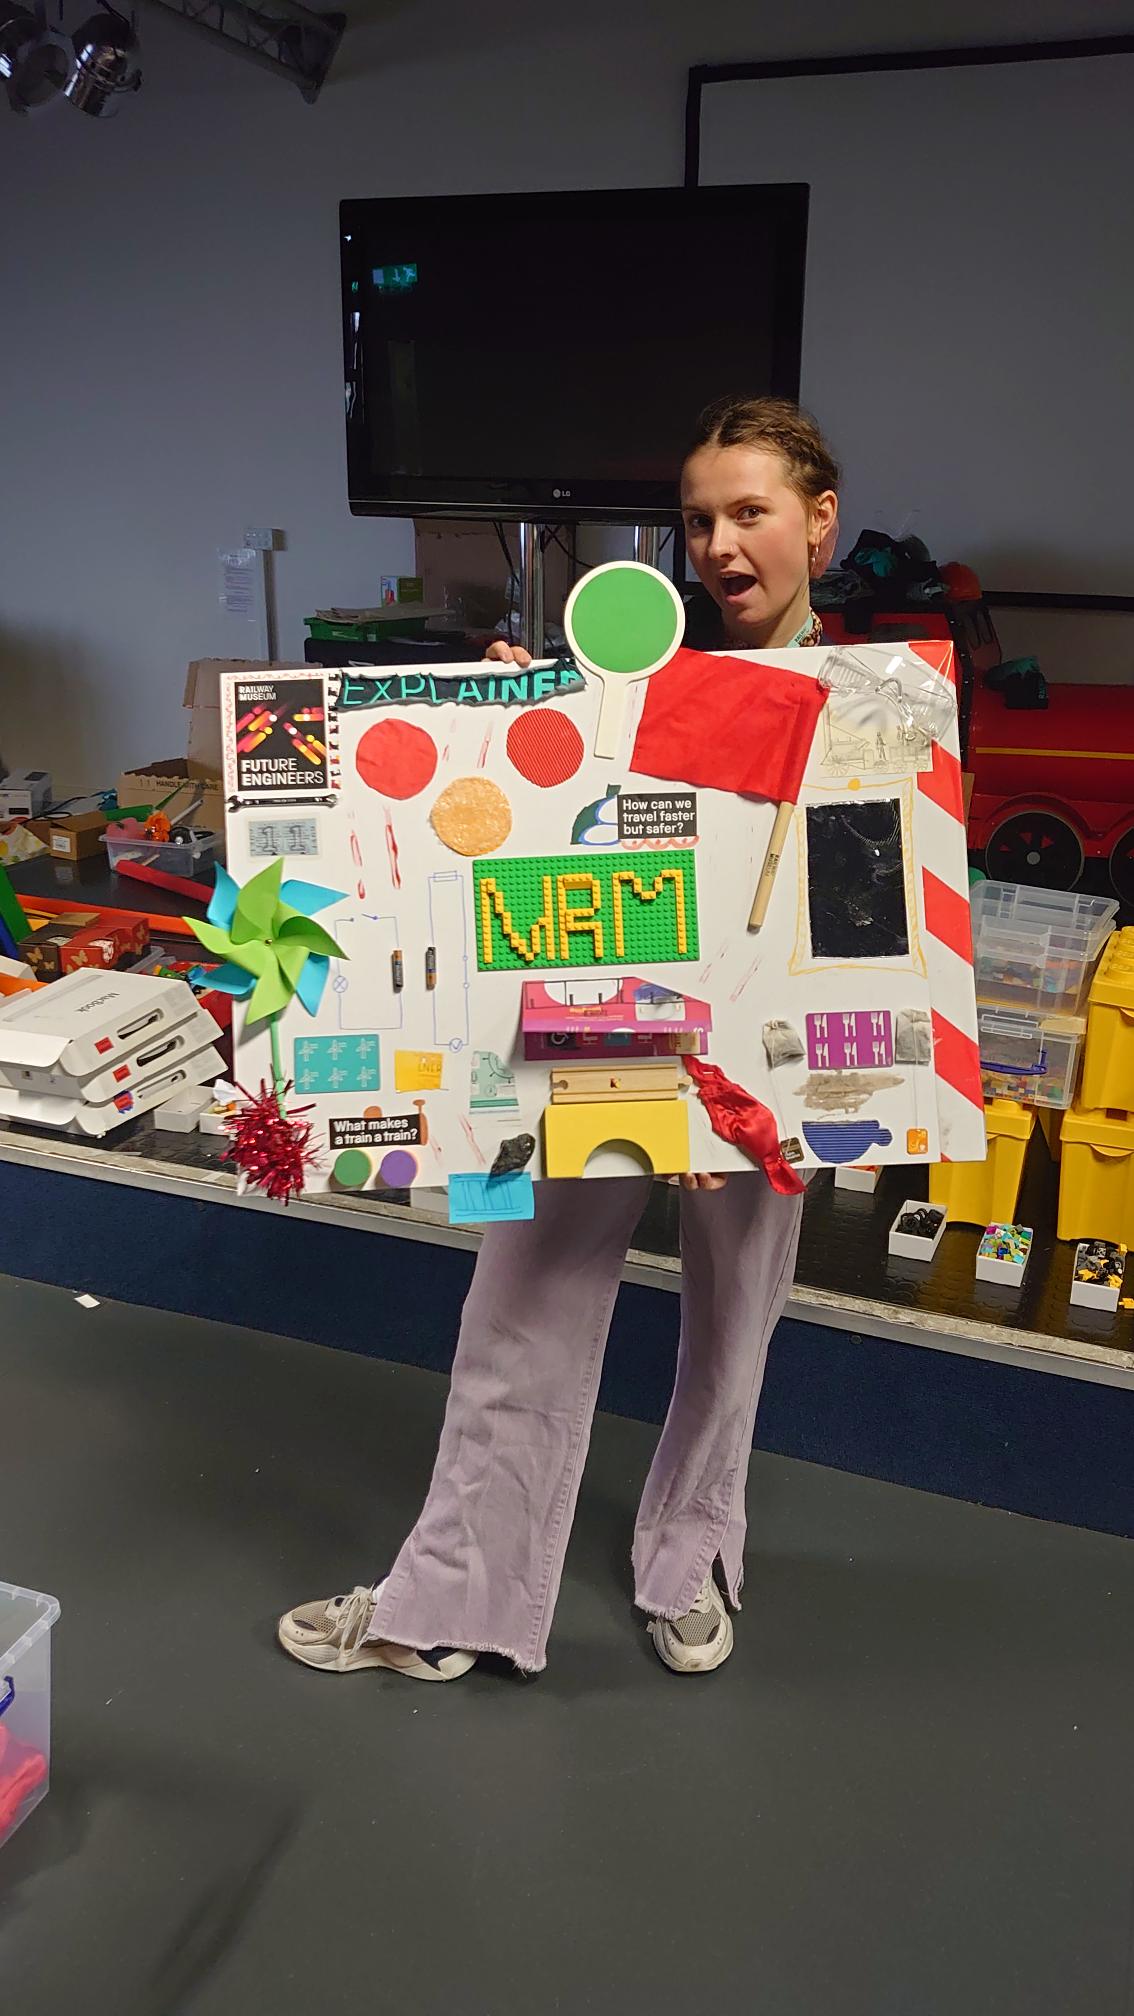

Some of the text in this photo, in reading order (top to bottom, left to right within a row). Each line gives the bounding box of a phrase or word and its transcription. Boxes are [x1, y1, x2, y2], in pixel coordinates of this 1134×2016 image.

[238, 685, 275, 694] RAILWAY
[238, 692, 277, 701] MUSEUM
[241, 758, 298, 772] FUTURE
[241, 771, 324, 786] ENGINEERS
[622, 799, 692, 810] How can we
[622, 810, 695, 823] travel faster
[623, 822, 684, 835] but safer?
[480, 869, 687, 964] NRM
[333, 1118, 409, 1133] What makes
[334, 1128, 418, 1145] a train a train?
